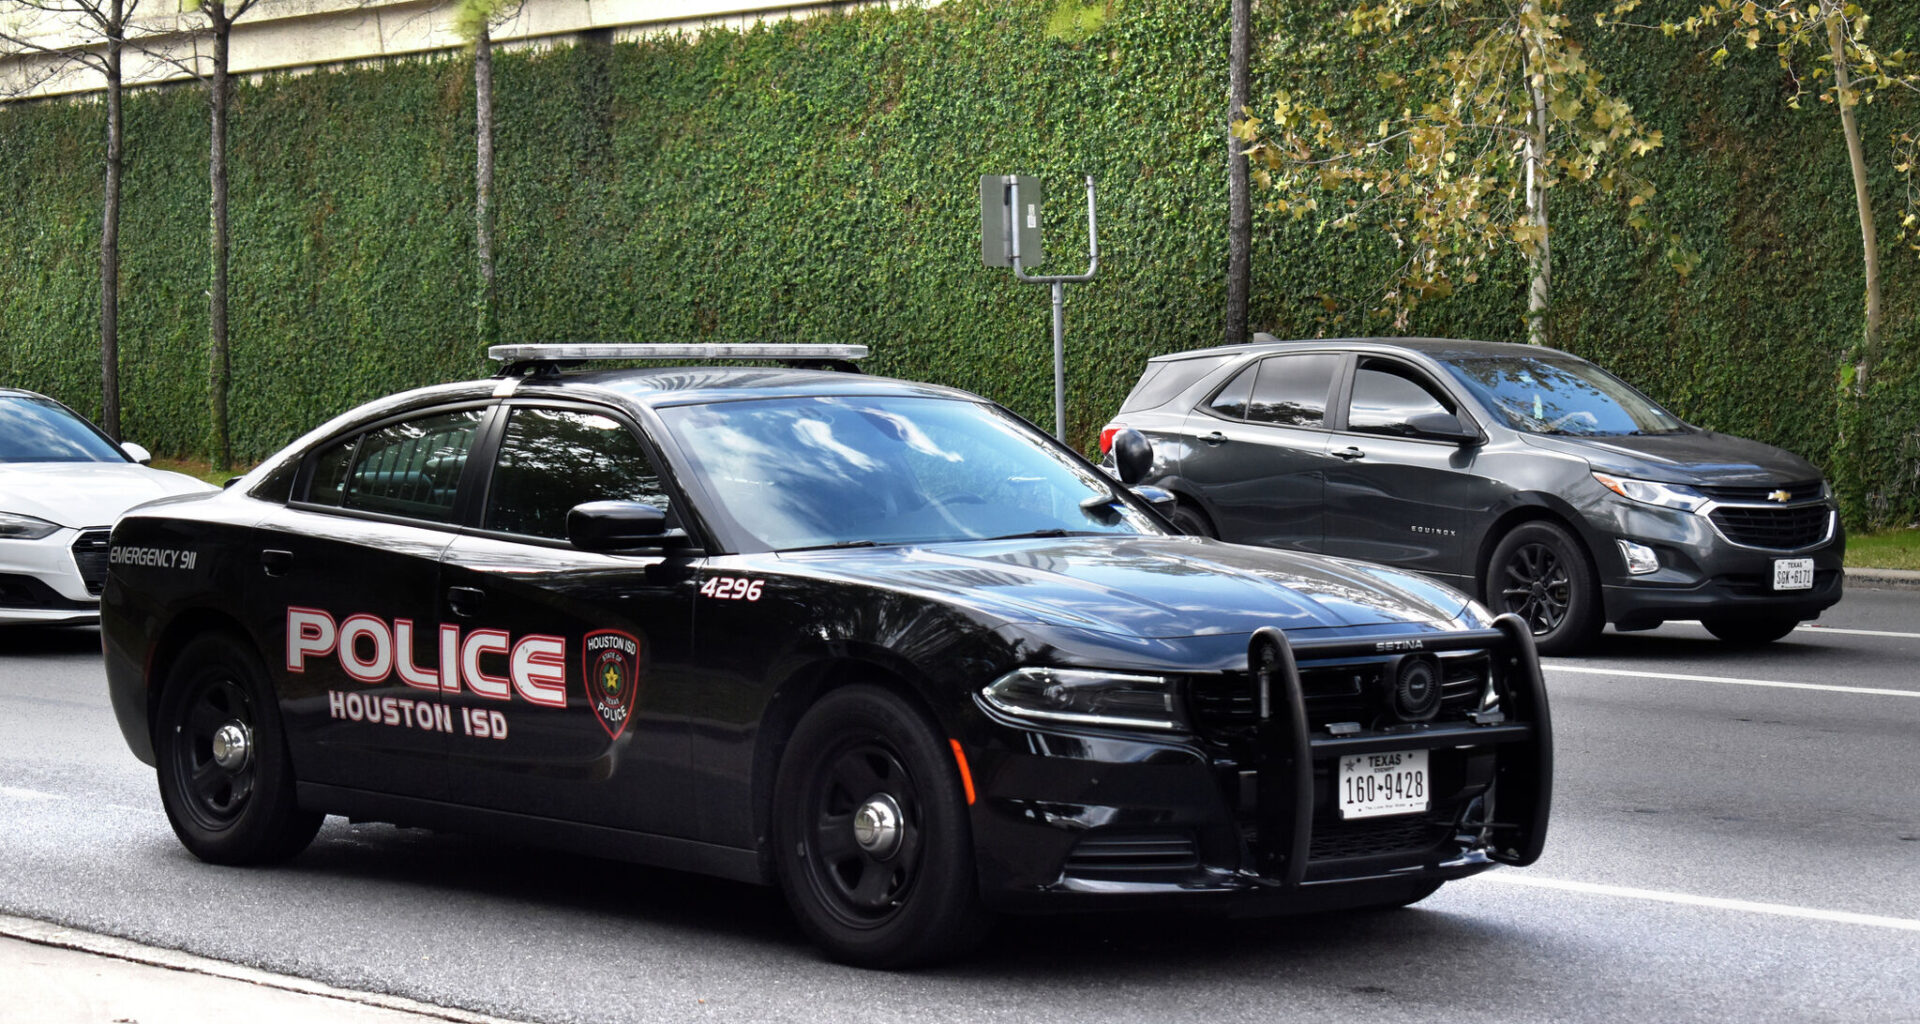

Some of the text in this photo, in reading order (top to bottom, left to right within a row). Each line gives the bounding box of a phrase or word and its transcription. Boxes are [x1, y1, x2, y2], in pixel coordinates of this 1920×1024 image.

[1411, 525, 1456, 537] EQUINOX
[109, 546, 197, 570] EMERGENCY 911
[700, 576, 765, 602] 4296
[587, 635, 637, 656] HOUSTON ISD
[1375, 639, 1424, 652] SETINA
[286, 605, 568, 709] POLICE
[328, 689, 509, 740] HOUSTON ISD
[597, 702, 628, 722] POLICE
[1367, 753, 1402, 768] TEXAS
